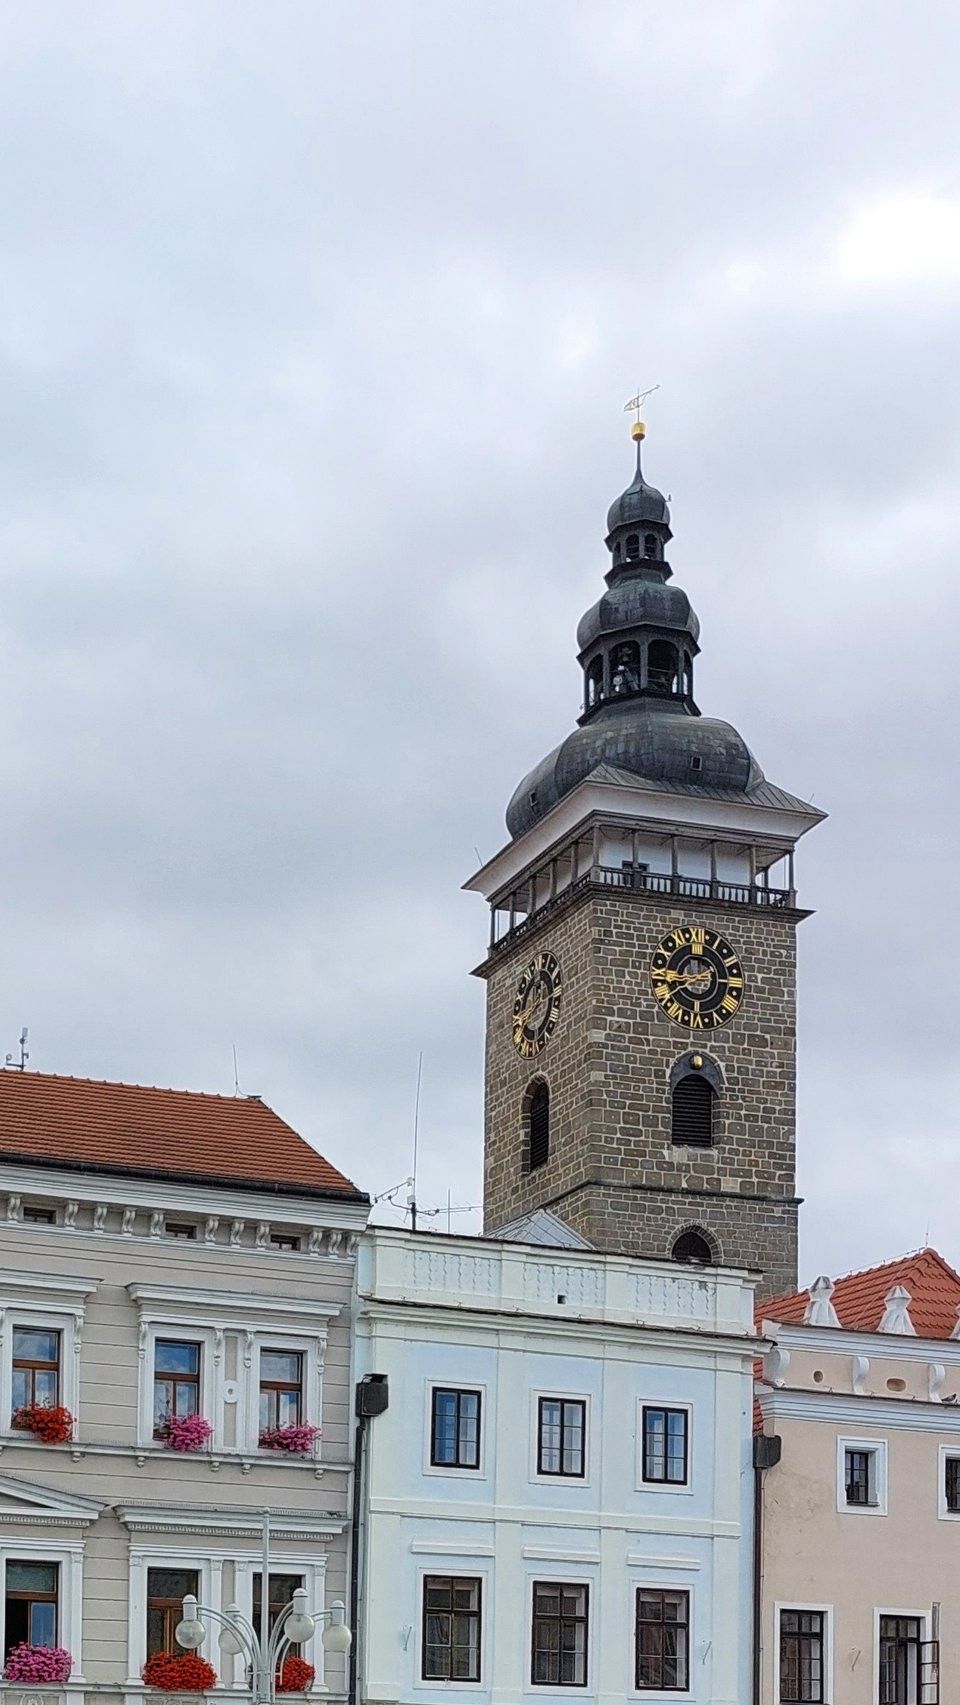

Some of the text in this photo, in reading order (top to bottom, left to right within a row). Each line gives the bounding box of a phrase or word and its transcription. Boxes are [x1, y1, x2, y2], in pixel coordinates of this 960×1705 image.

[670, 929, 686, 948] XI
[689, 928, 705, 943] XII
[656, 943, 672, 960] X
